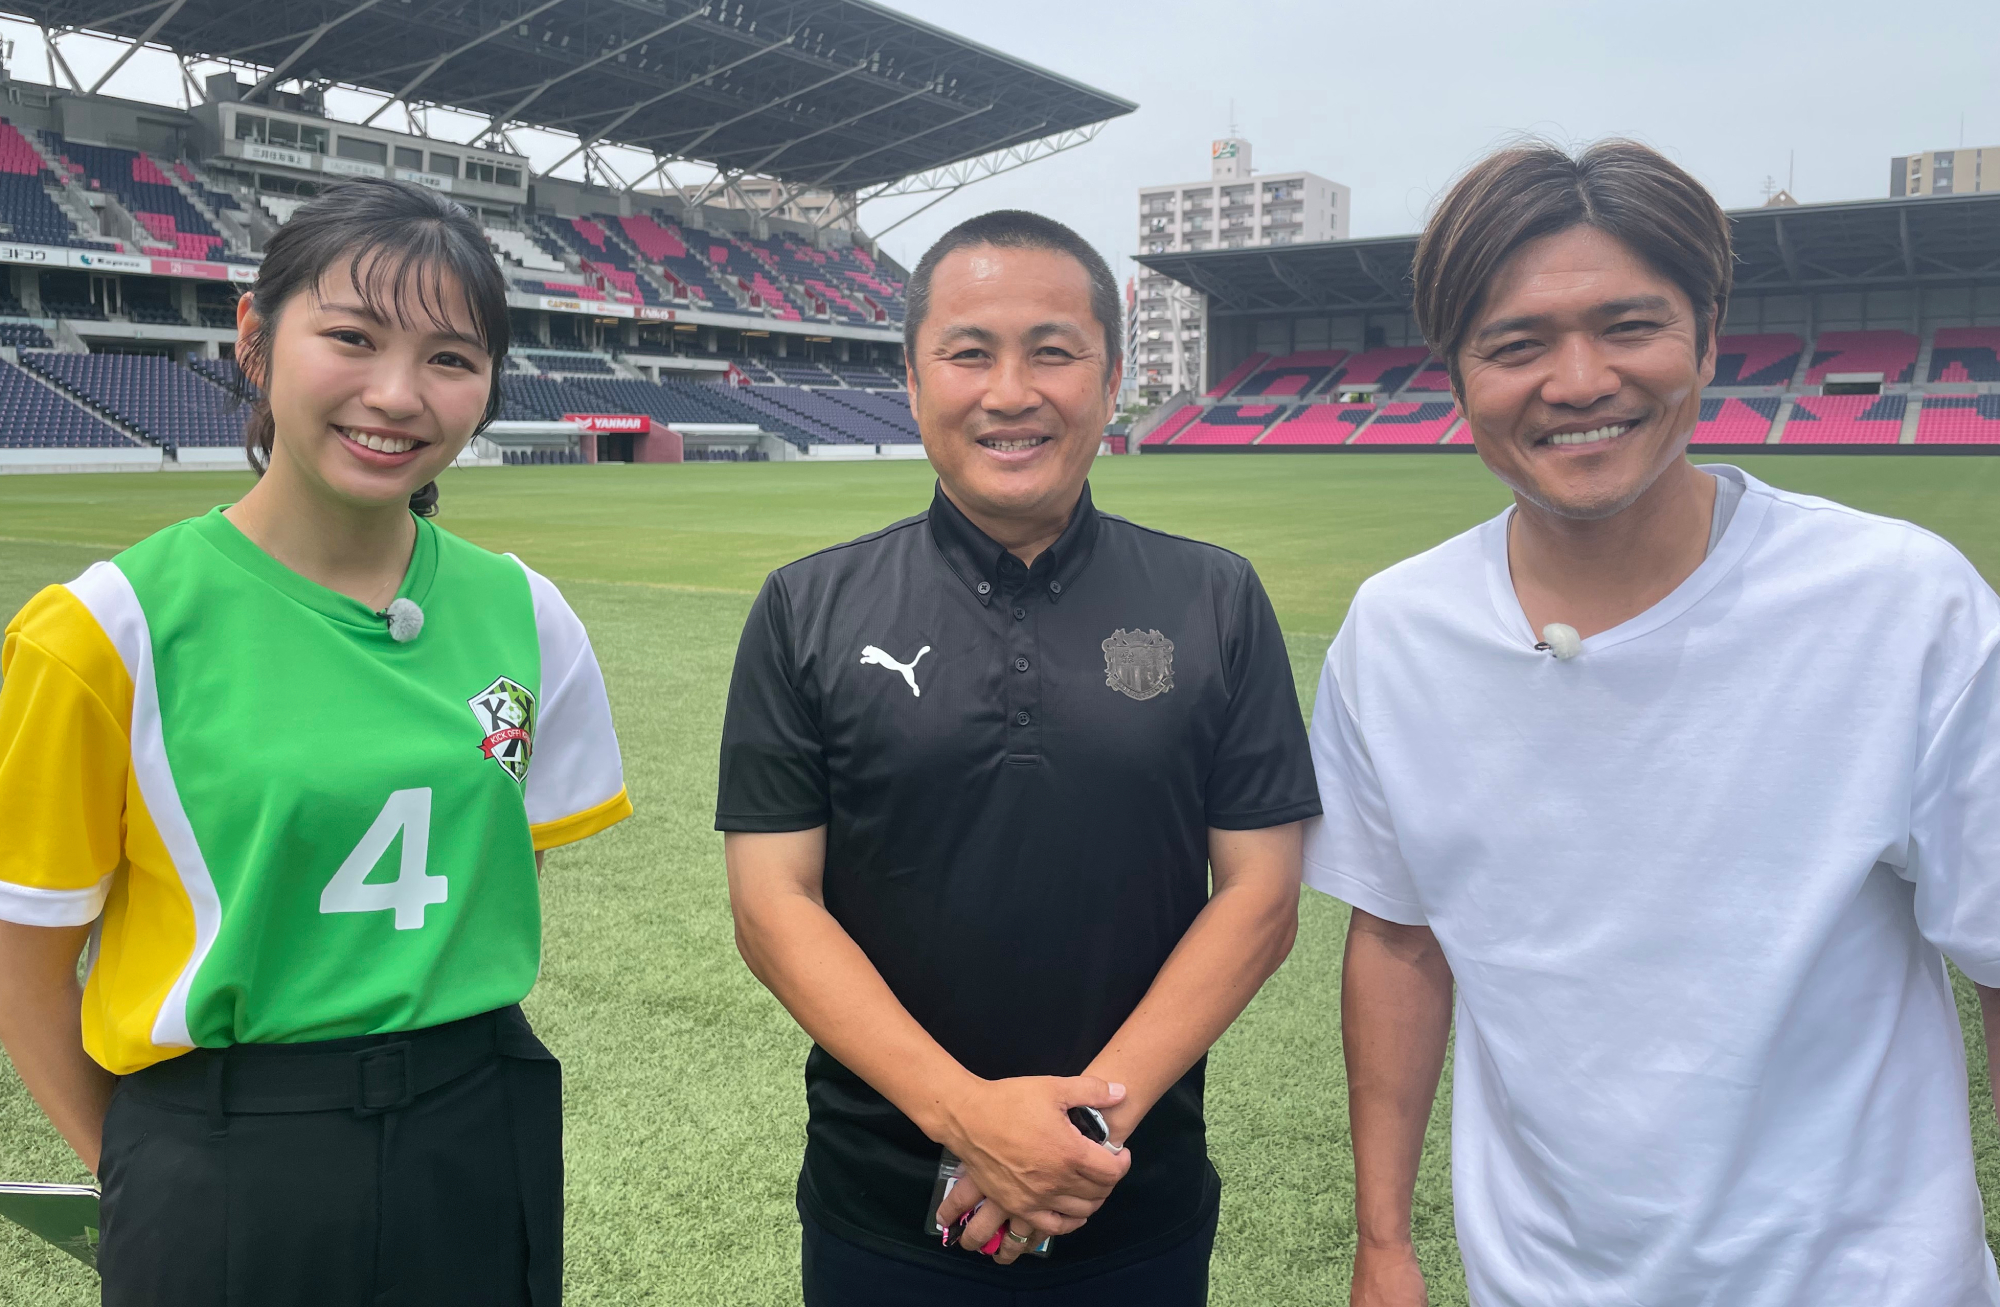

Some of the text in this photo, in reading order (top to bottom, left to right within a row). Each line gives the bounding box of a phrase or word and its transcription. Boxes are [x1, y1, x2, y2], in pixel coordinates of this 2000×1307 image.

[594, 417, 641, 429] YANMAR
[490, 730, 508, 745] KICK
[319, 787, 448, 930] 4
